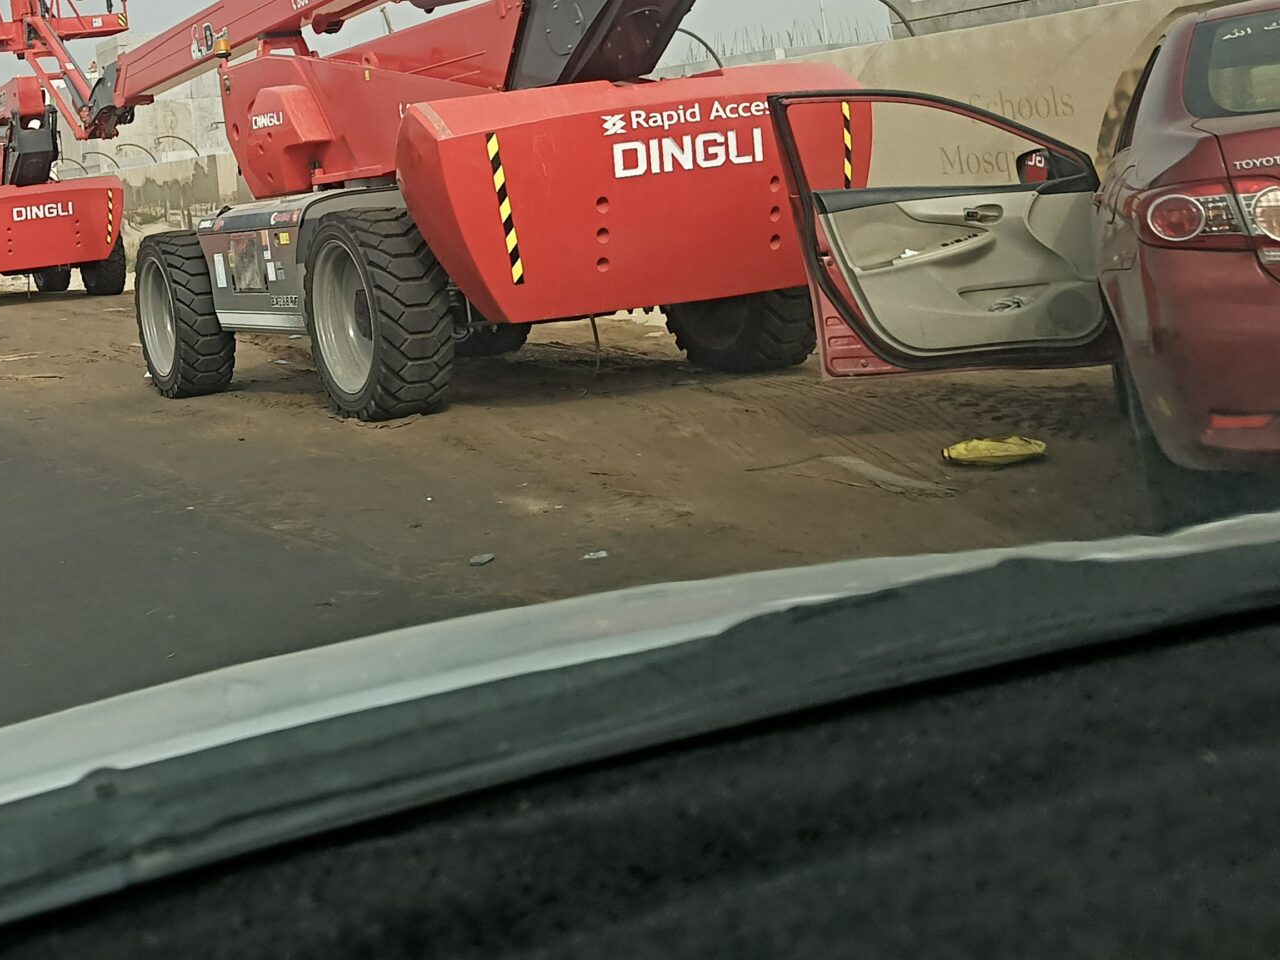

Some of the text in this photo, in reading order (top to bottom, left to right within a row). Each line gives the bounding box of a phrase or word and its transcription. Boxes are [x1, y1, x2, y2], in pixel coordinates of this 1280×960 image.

[252, 111, 283, 130] DINGLI
[630, 102, 701, 130] Rapid
[612, 127, 764, 179] DINGLI
[939, 144, 1016, 182] Mosq
[1232, 155, 1280, 170] TOYOT
[12, 201, 73, 222] DINGLI
